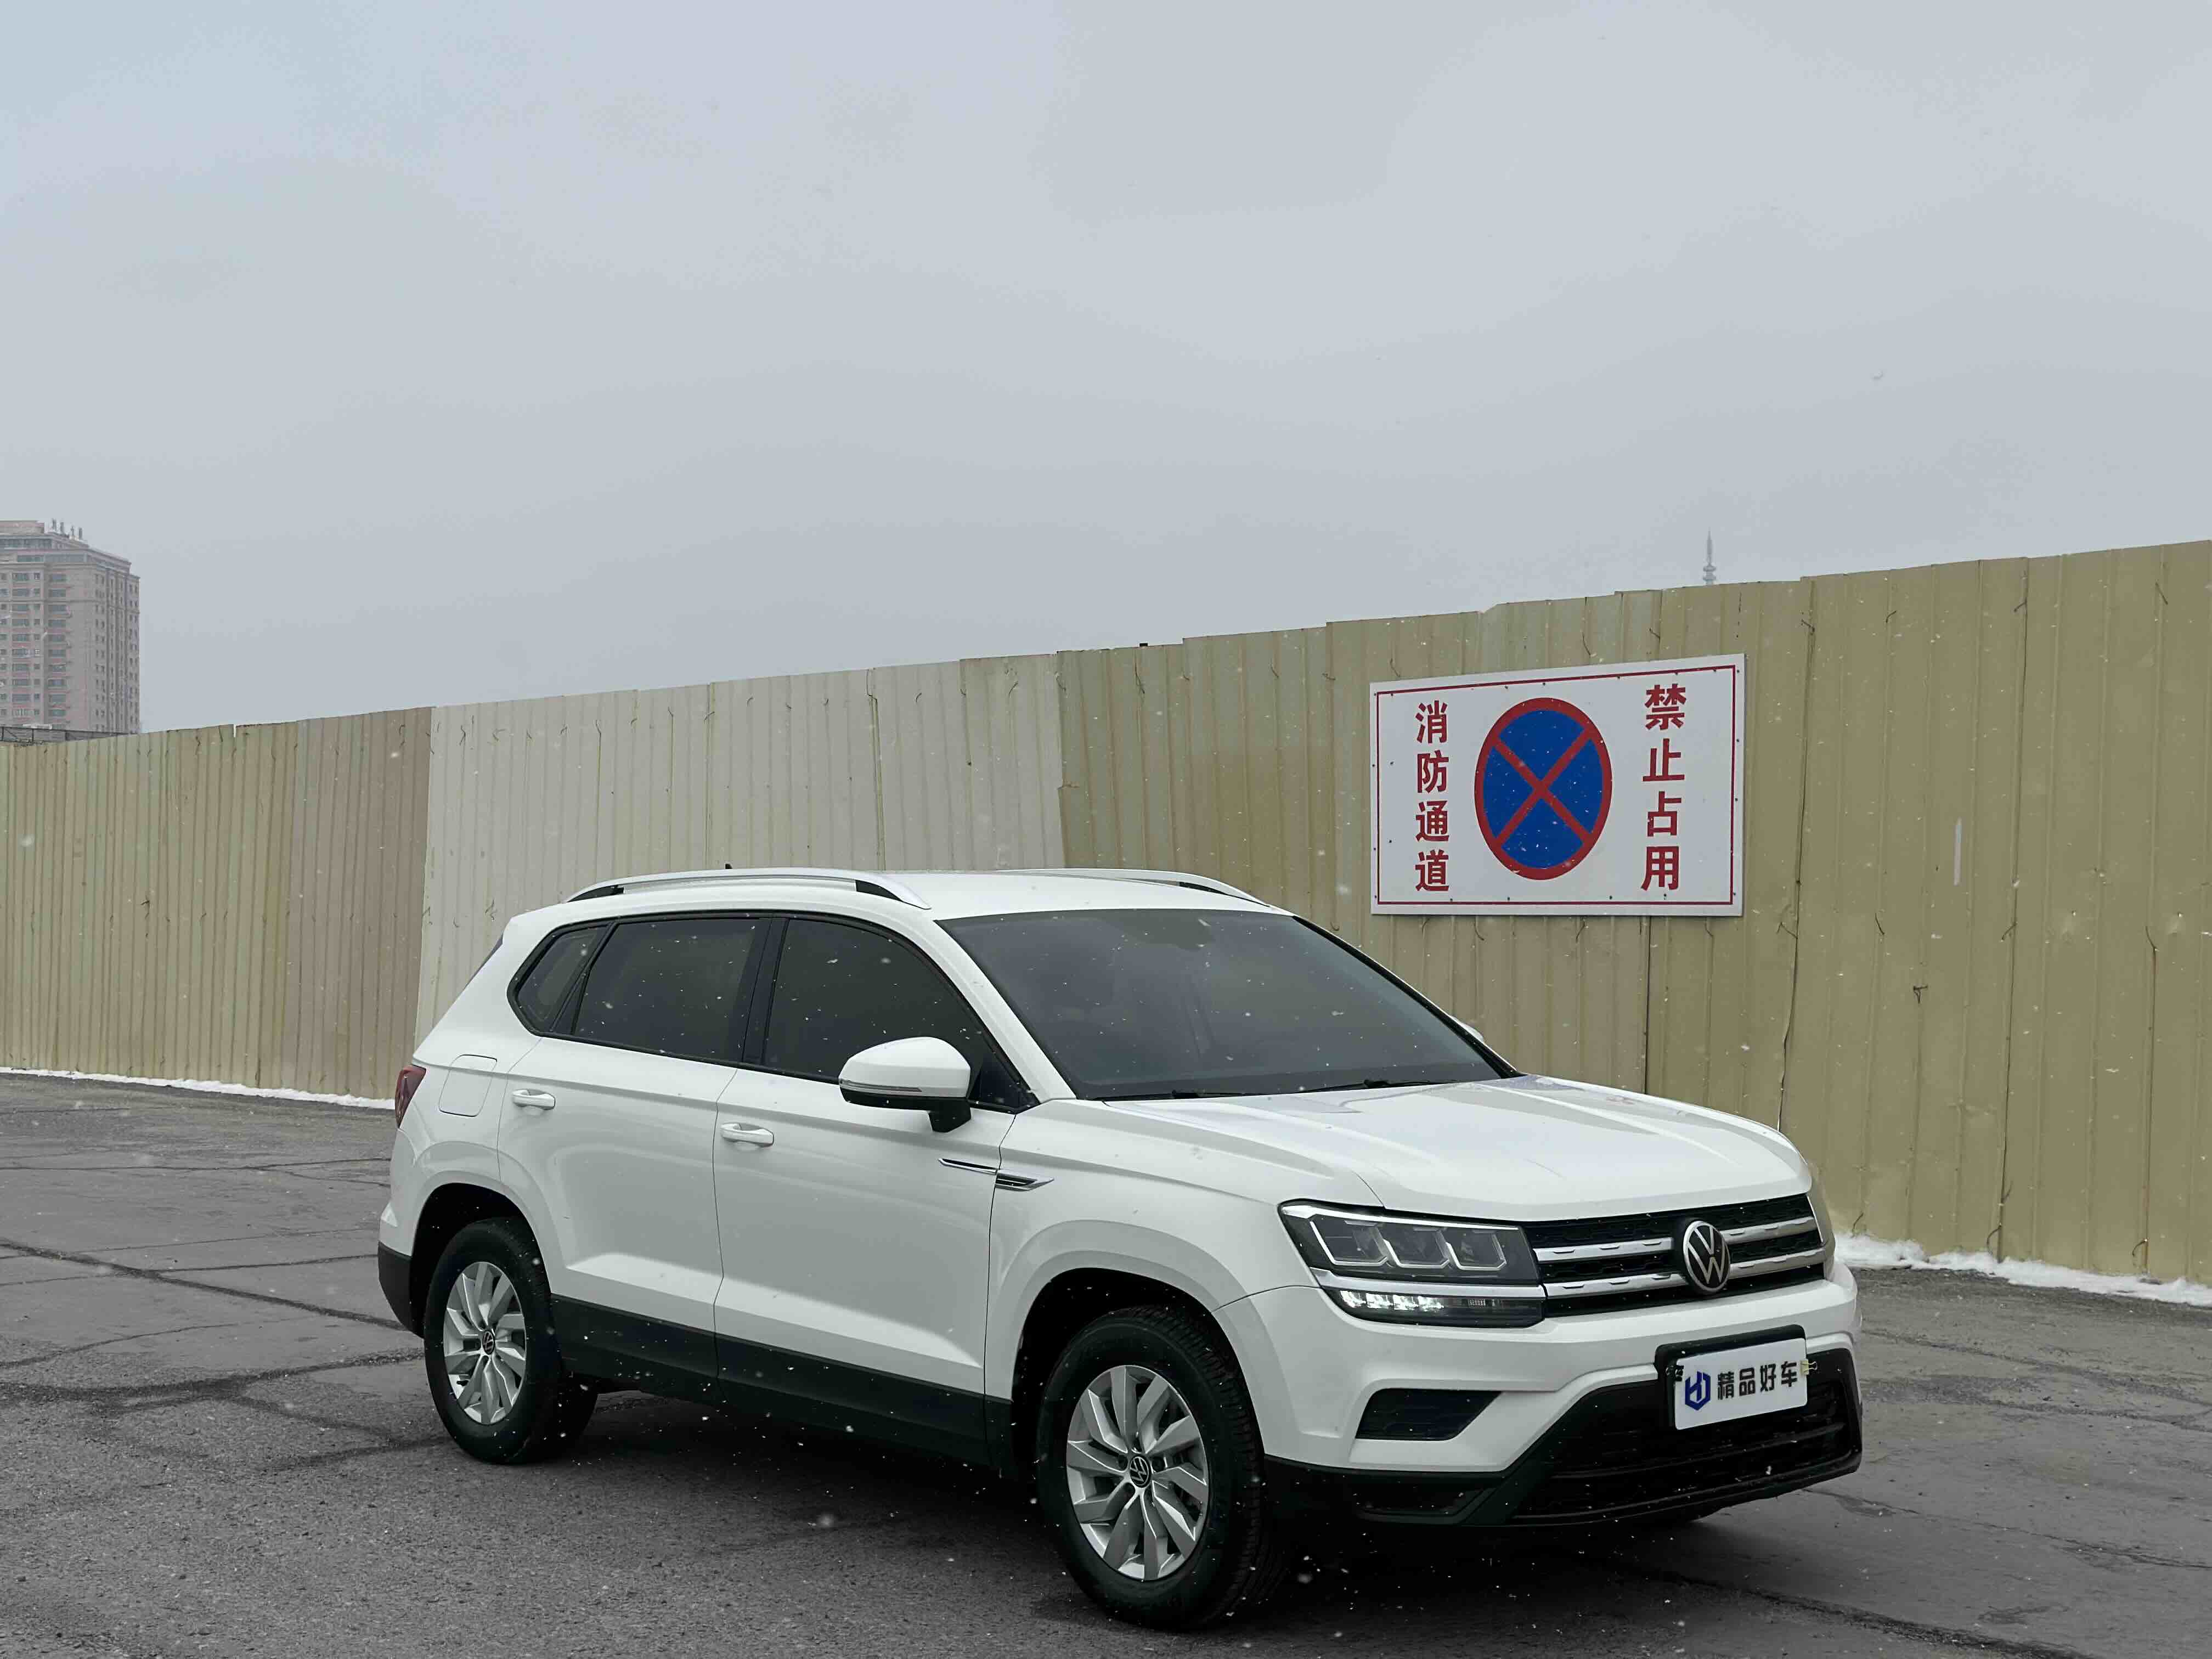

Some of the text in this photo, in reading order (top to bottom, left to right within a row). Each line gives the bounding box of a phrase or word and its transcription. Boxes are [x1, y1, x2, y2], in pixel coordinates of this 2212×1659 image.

[1415, 700, 1449, 891] 消防通道
[1641, 683, 1686, 891] 禁止占用
[1684, 1222, 1729, 1290] VW
[1717, 1361, 1798, 1400] 精品好车
